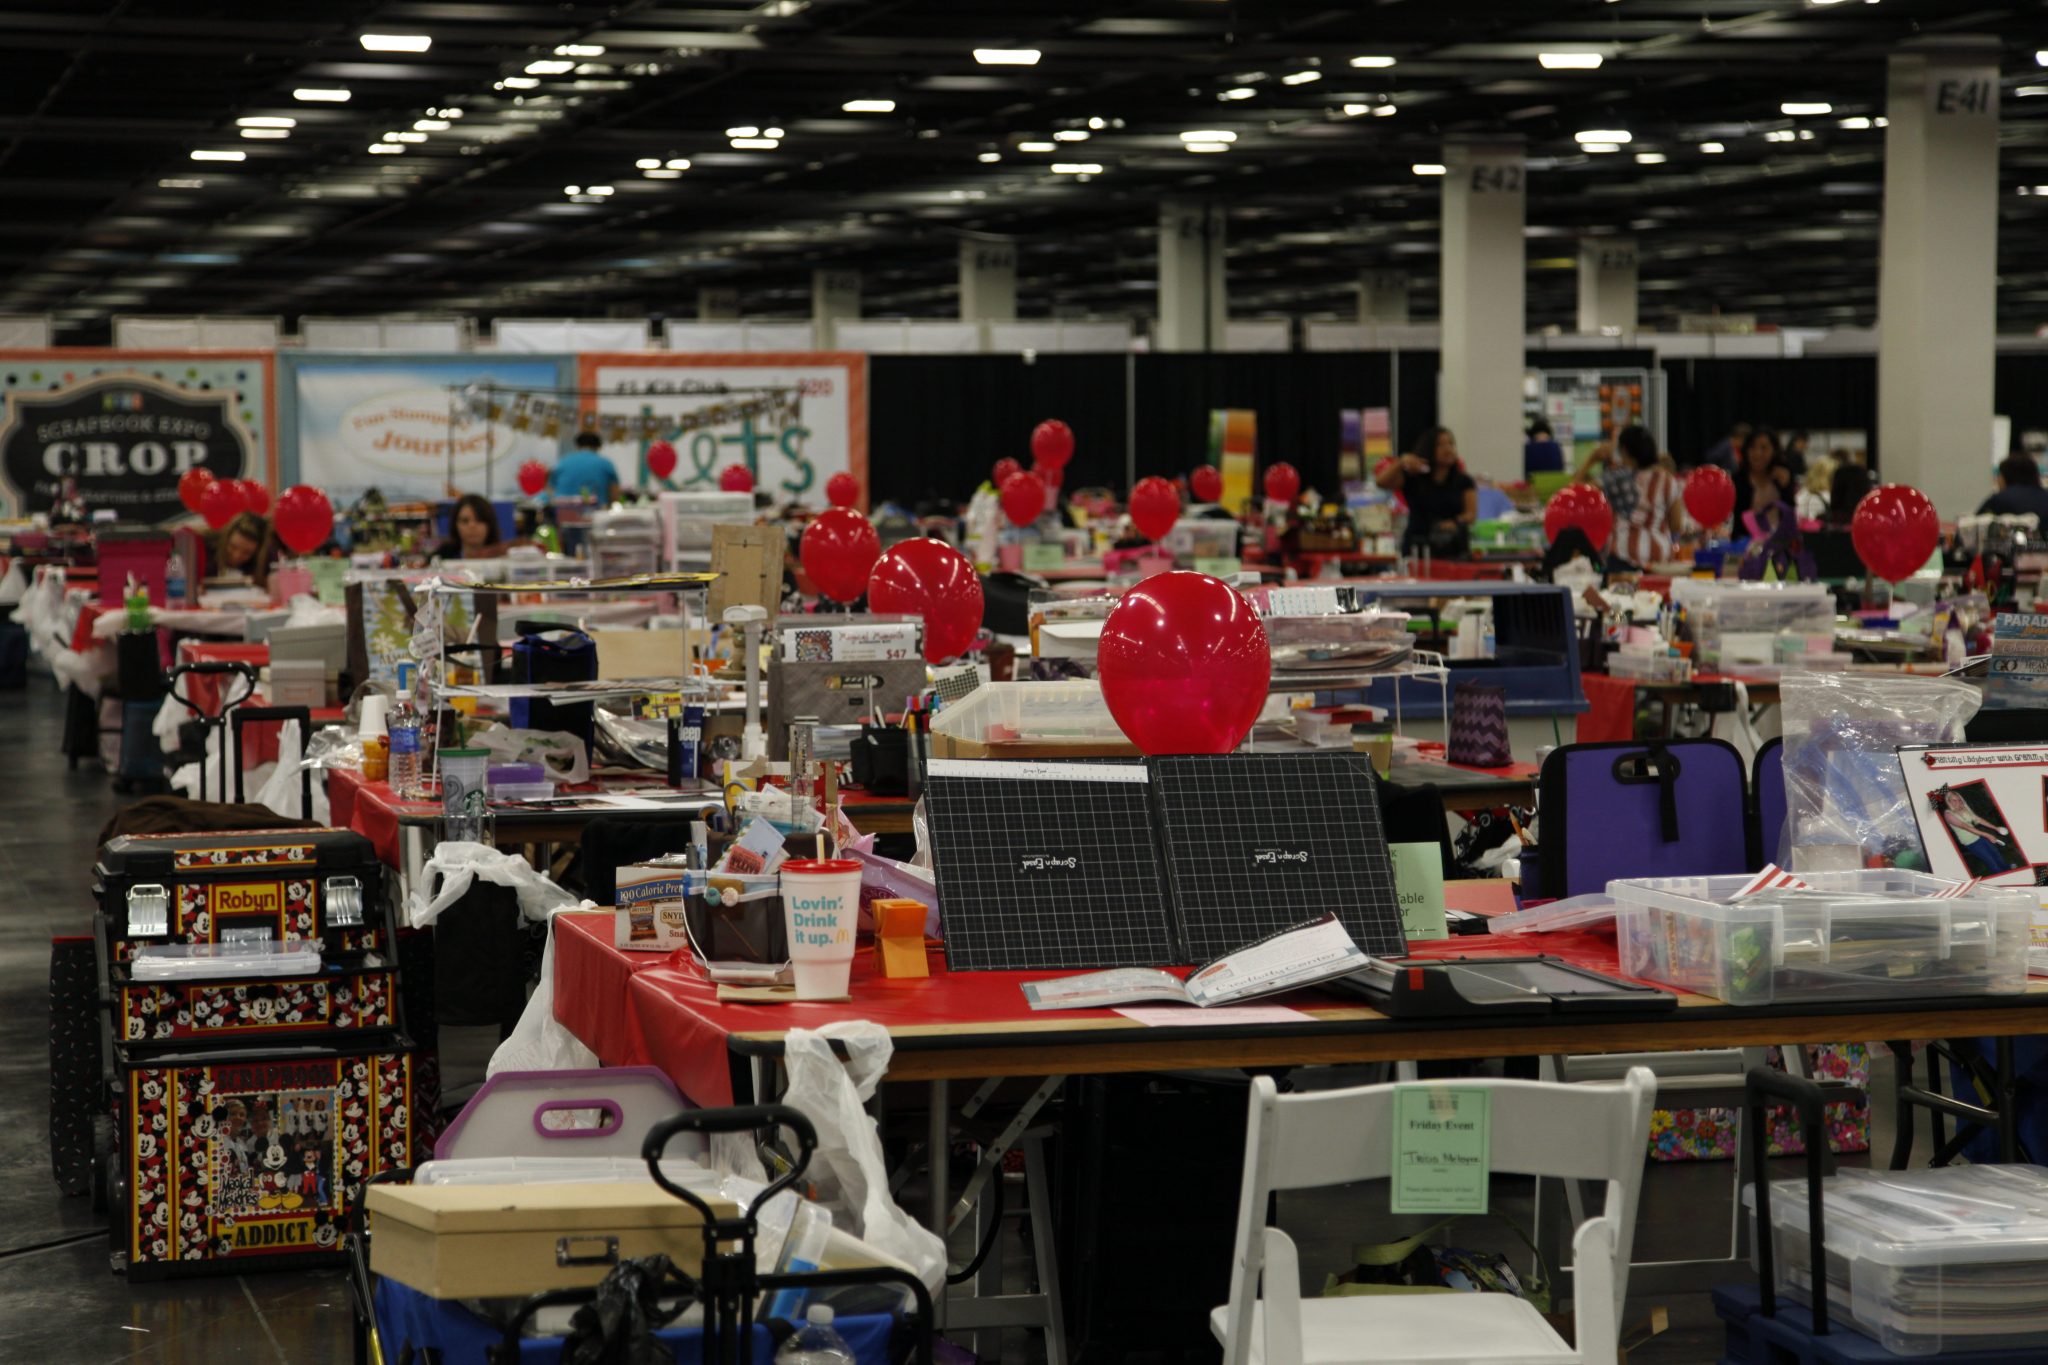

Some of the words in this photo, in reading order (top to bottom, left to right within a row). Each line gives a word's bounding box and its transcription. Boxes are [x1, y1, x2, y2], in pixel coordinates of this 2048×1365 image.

[1938, 79, 1990, 114] E41
[1472, 165, 1519, 192] E42
[36, 414, 155, 443] SCRAPBOOK
[158, 415, 212, 440] EXPO
[42, 440, 209, 477] CROP
[886, 648, 907, 660] $47
[219, 890, 276, 911] Robyn
[636, 883, 664, 898] Calorie
[794, 913, 837, 927] Drink
[795, 929, 804, 943] it
[809, 934, 833, 947] up.
[217, 1065, 335, 1090] SCRAPBOOK
[1409, 1120, 1442, 1132] Friday
[1445, 1120, 1475, 1131] Event
[234, 1221, 310, 1248] ADDICT
